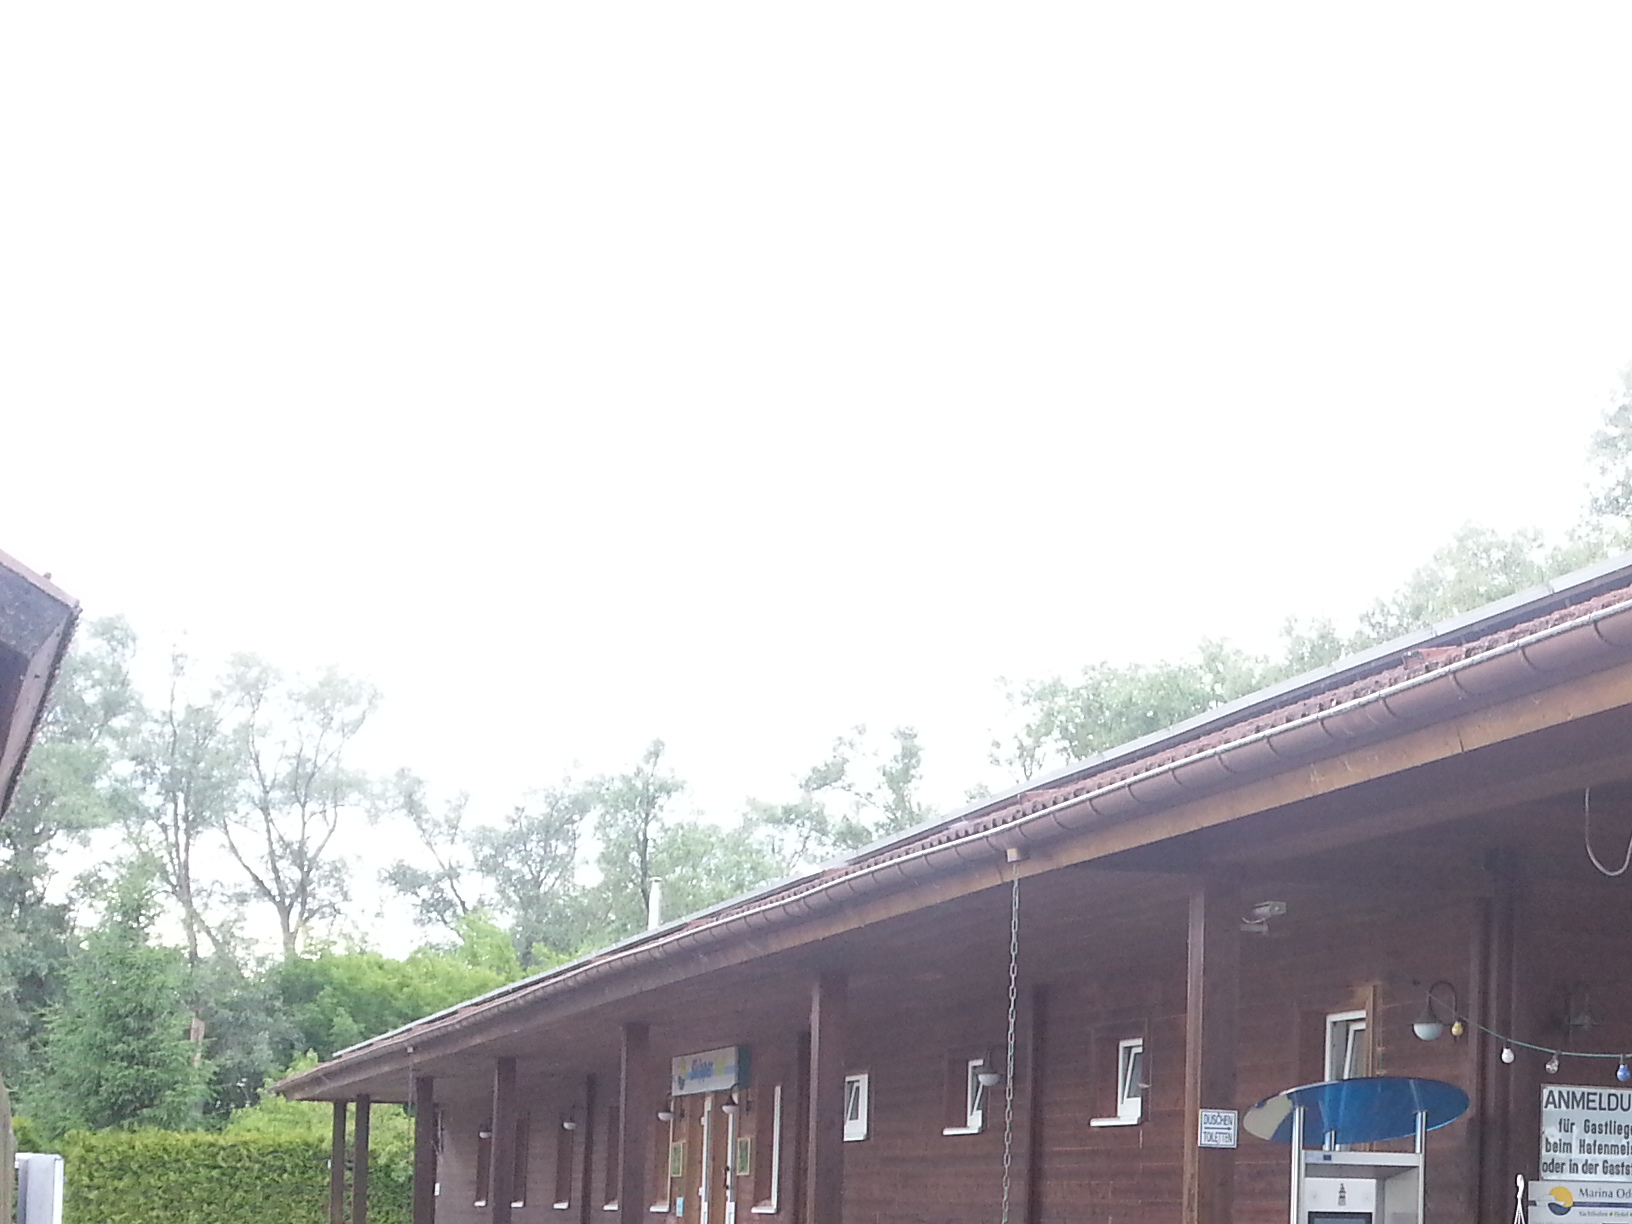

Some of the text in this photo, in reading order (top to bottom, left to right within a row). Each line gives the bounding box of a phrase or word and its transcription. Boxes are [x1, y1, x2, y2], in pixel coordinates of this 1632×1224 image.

[1558, 1118, 1575, 1134] für
[1545, 1138, 1573, 1154] beim
[1541, 1158, 1566, 1174] oder
[1569, 1159, 1579, 1174] in
[1582, 1159, 1599, 1175] der
[1579, 1187, 1613, 1198] Marina
